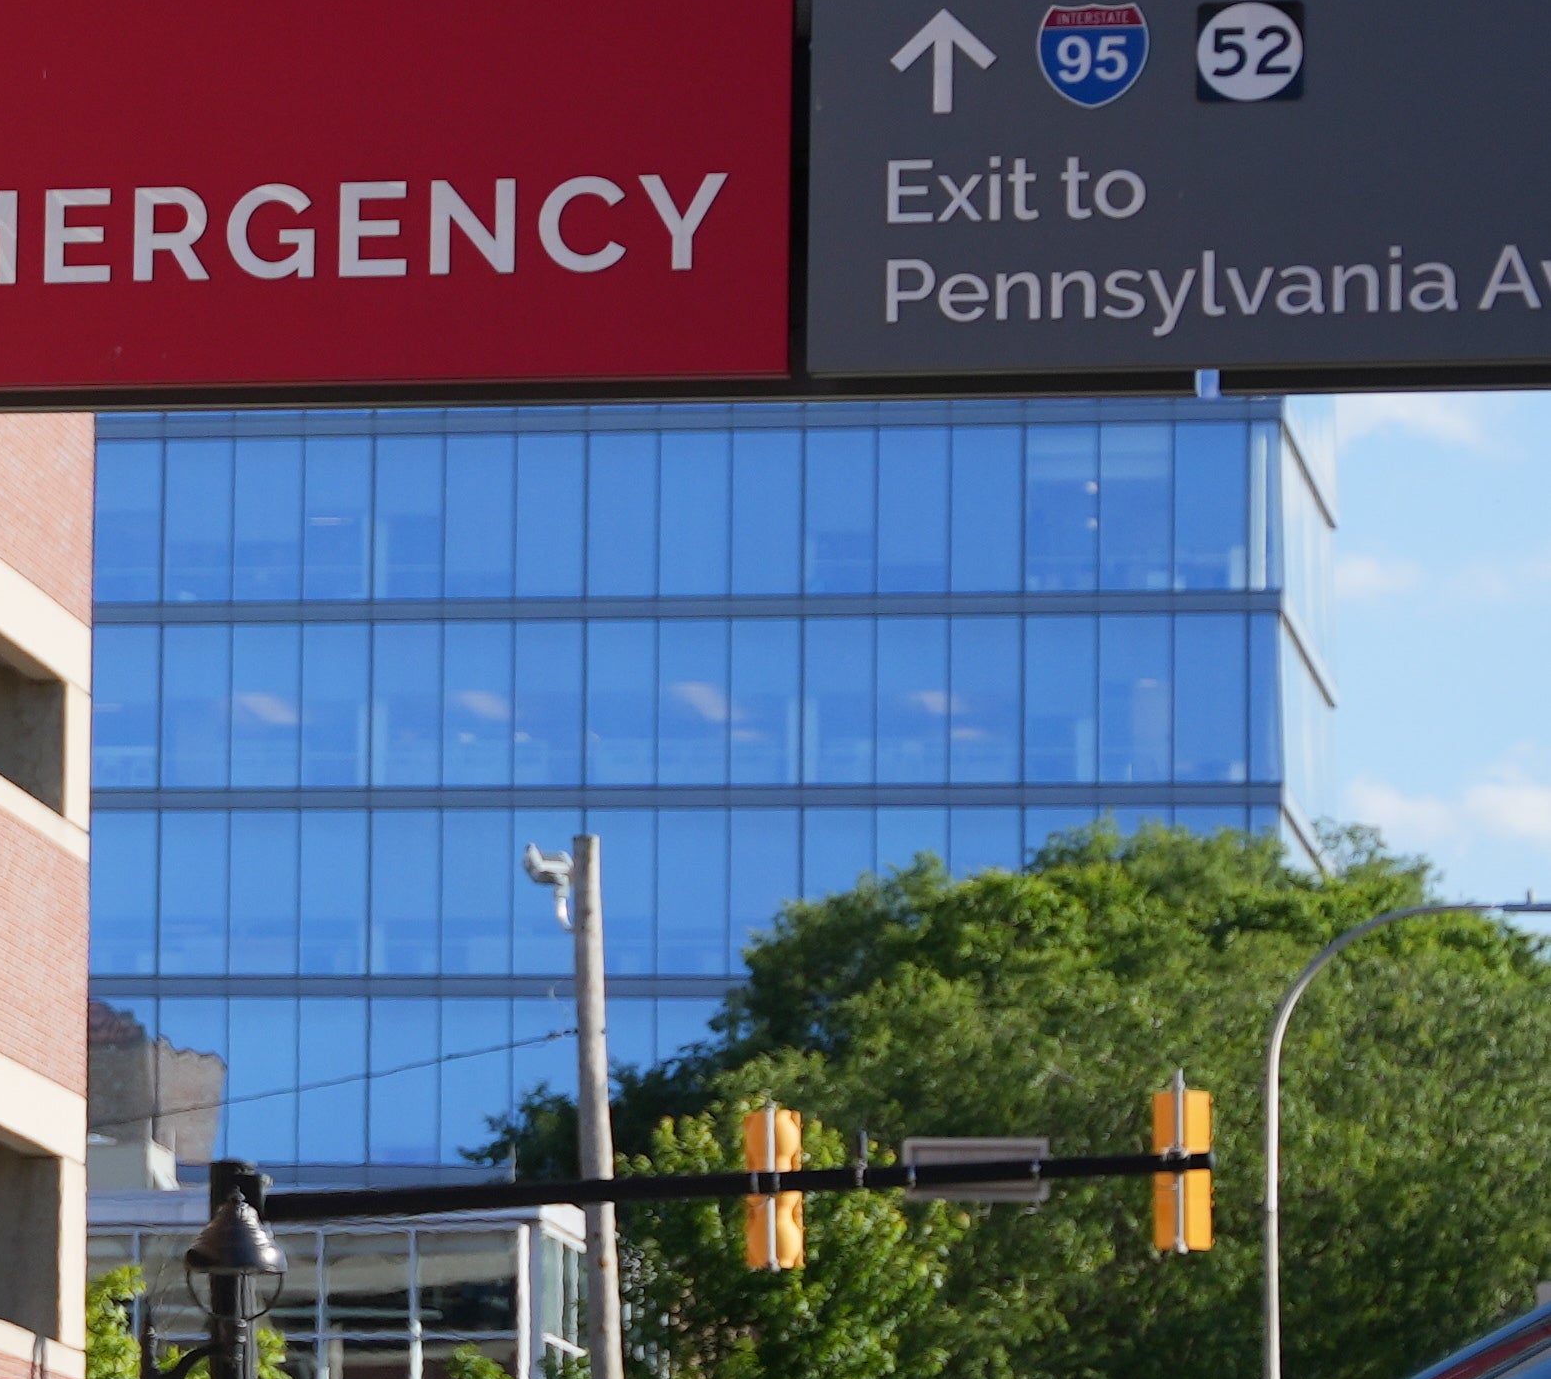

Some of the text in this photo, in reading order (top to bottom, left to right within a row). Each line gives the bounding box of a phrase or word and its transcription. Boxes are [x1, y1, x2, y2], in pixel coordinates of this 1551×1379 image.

[1056, 10, 1129, 24] INTERSTATE
[1056, 35, 1129, 83] 95
[1212, 25, 1293, 77] 52
[886, 156, 1147, 224] Exit to
[885, 243, 1551, 337] Pennsylvania A
